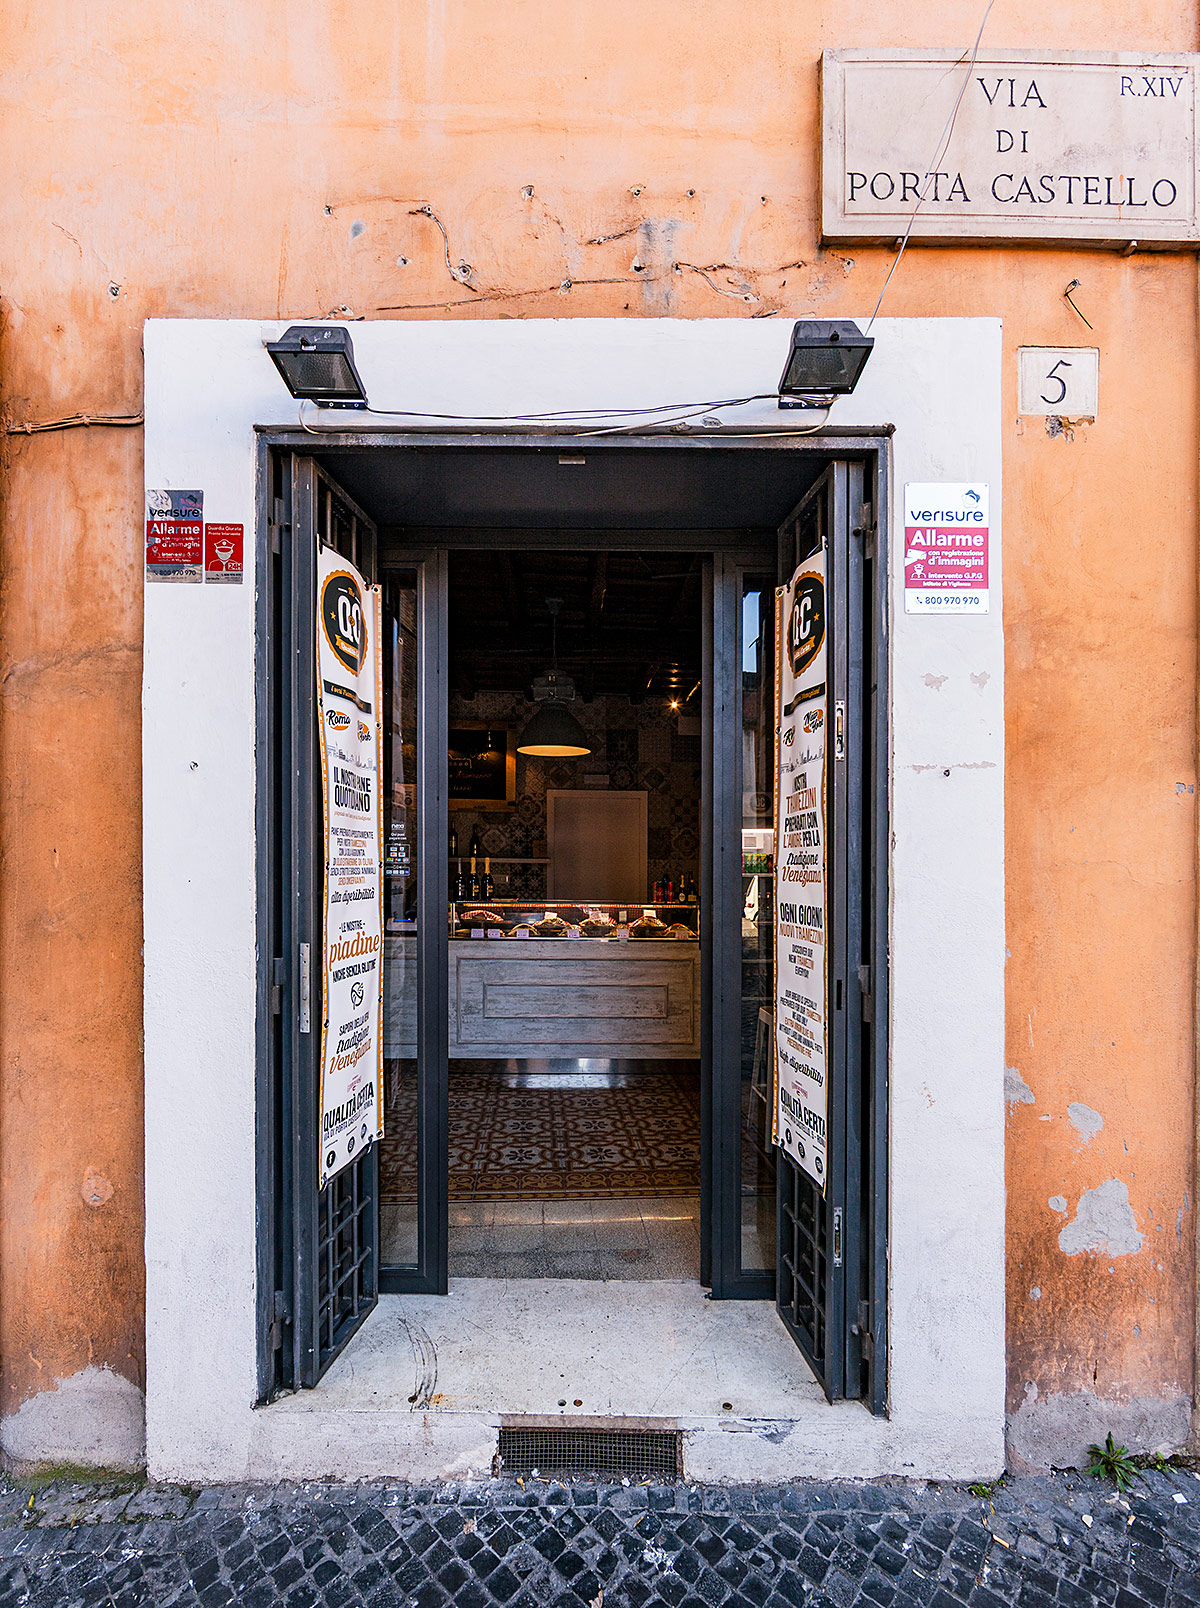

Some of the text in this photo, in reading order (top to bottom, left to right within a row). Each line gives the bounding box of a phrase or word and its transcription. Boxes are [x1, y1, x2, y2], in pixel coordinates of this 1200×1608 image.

[977, 78, 1048, 108] VIA
[1120, 76, 1183, 98] R.XIV
[996, 130, 1029, 153] DI
[847, 172, 1178, 207] PORTA CASTELLO
[1040, 359, 1072, 404] 5
[150, 508, 200, 518] verisure
[911, 510, 984, 521] verisure
[150, 522, 200, 535] Allarme
[911, 529, 985, 547] Allarme
[928, 556, 984, 568] d'immagini
[925, 596, 980, 605] 800 970 970
[326, 710, 351, 725] Roma
[334, 766, 340, 783] IL
[803, 830, 812, 847] PER
[813, 829, 821, 847] LA
[780, 902, 797, 924] OGNI
[329, 931, 379, 972] piadine
[346, 963, 361, 979] SENZA
[323, 1094, 356, 1132] QUALITÀ
